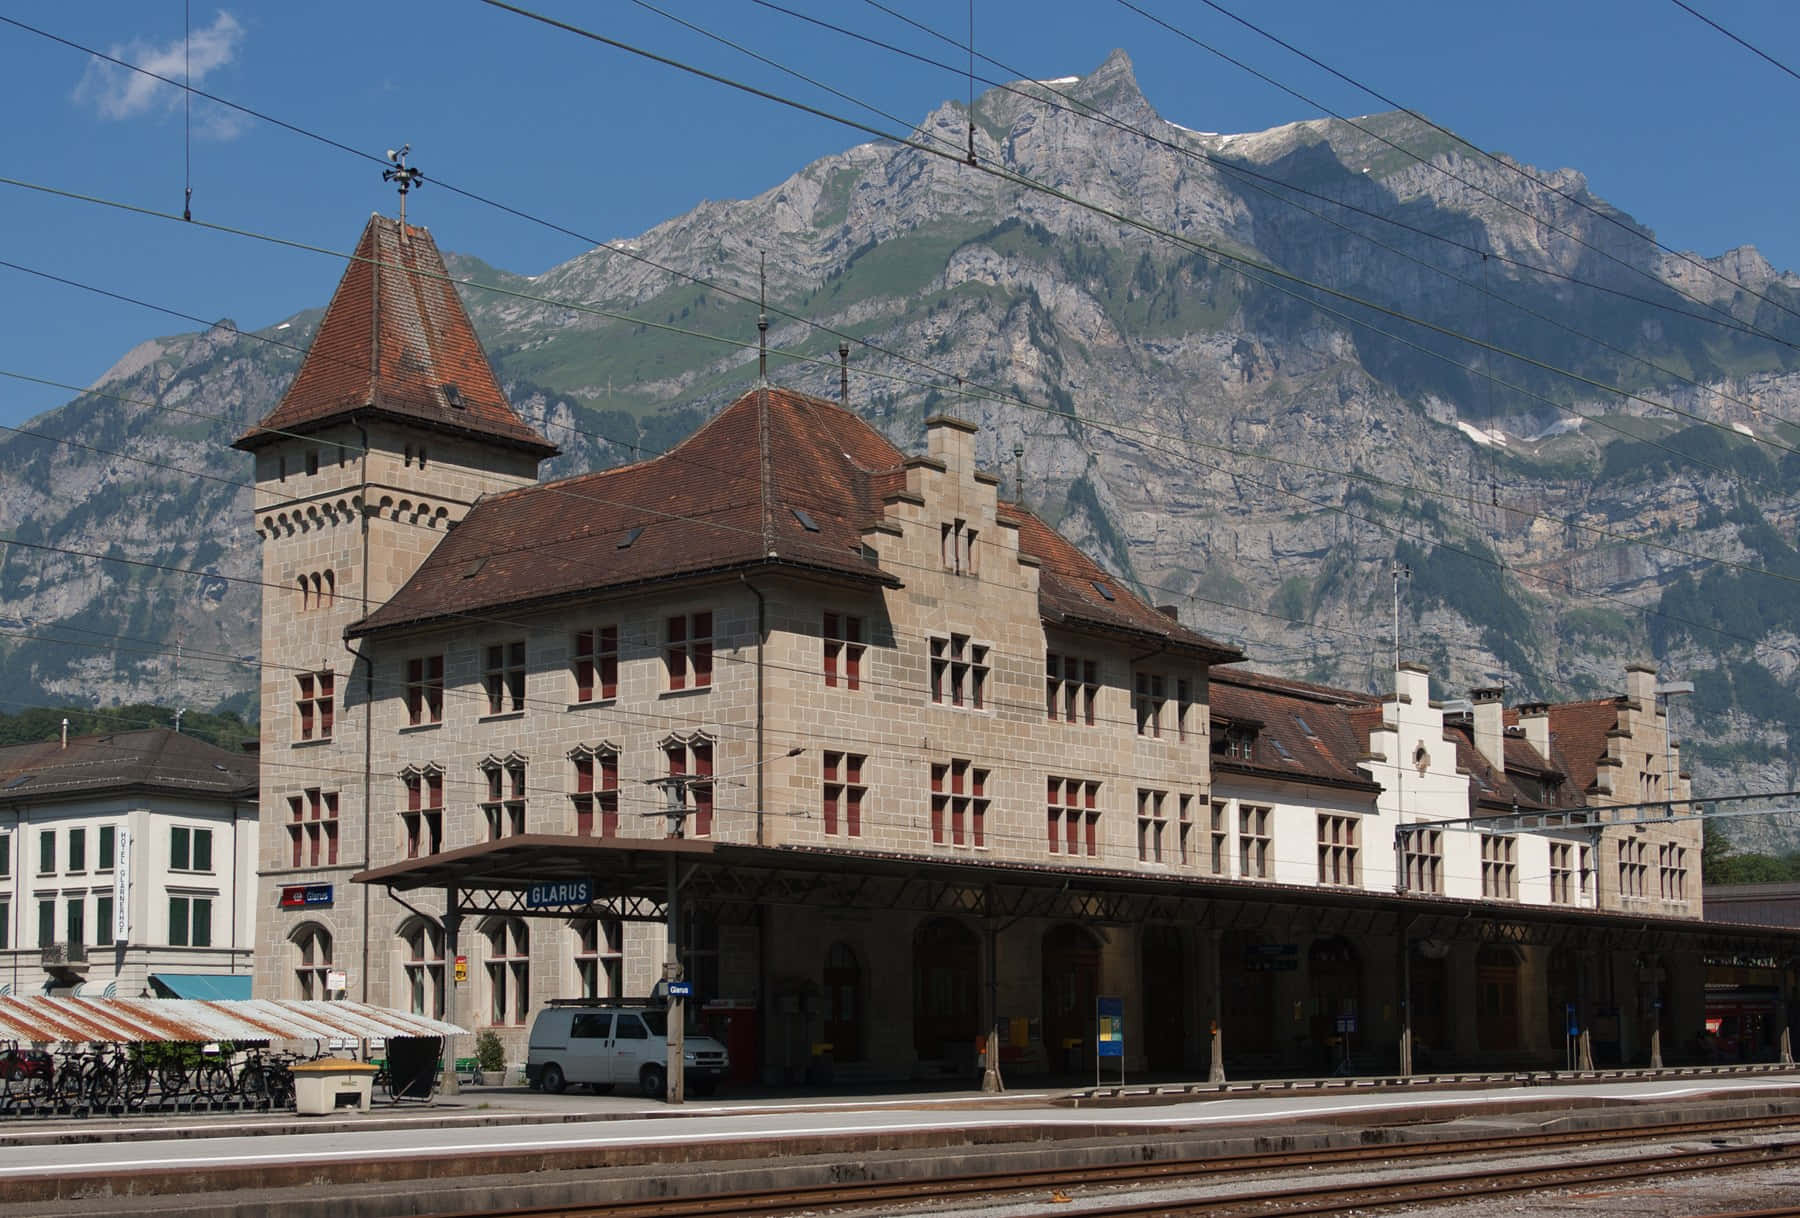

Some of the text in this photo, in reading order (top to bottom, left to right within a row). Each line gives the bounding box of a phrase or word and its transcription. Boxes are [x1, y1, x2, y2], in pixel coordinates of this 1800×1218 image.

[307, 891, 328, 902] Glarus
[532, 883, 587, 903] GLARUS
[670, 985, 689, 994] Glarus
